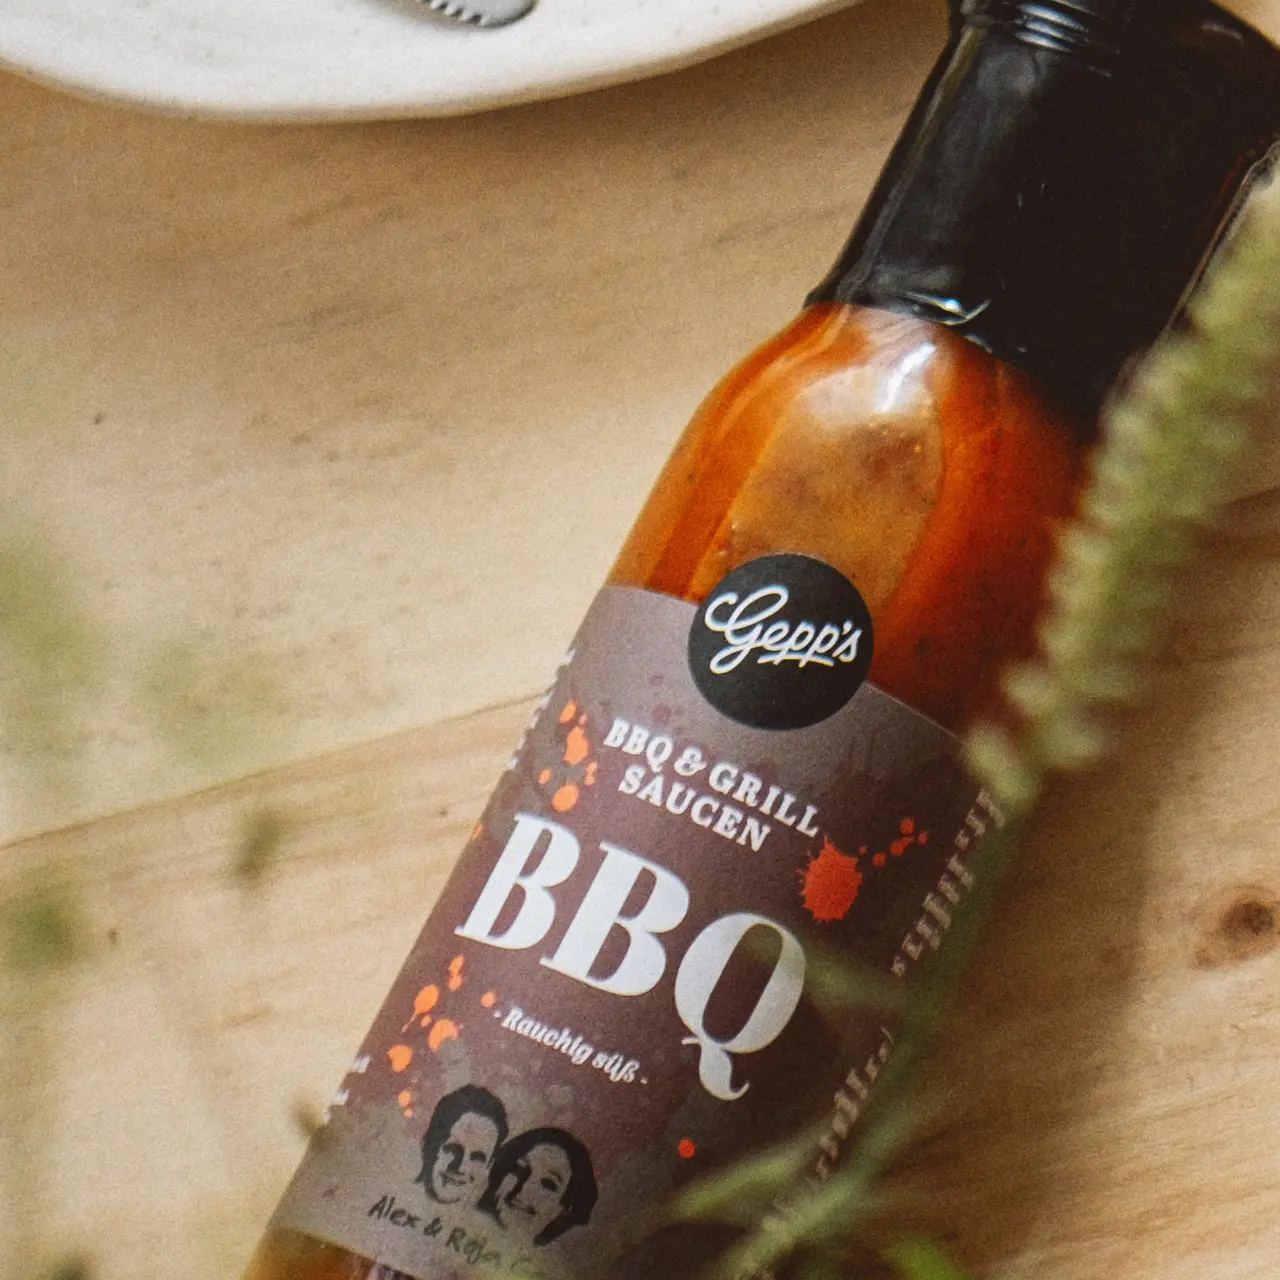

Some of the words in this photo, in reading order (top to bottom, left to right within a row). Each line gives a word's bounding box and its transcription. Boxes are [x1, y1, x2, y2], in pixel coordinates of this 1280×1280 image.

[704, 584, 862, 674] Gepp's
[602, 715, 674, 773] BBQ
[673, 746, 707, 777] &
[708, 762, 821, 838] GRILL
[618, 764, 771, 853] SAUCEN
[454, 812, 806, 1101] BBQ
[501, 1006, 594, 1065] Rauchig
[368, 1194, 416, 1230] Alex
